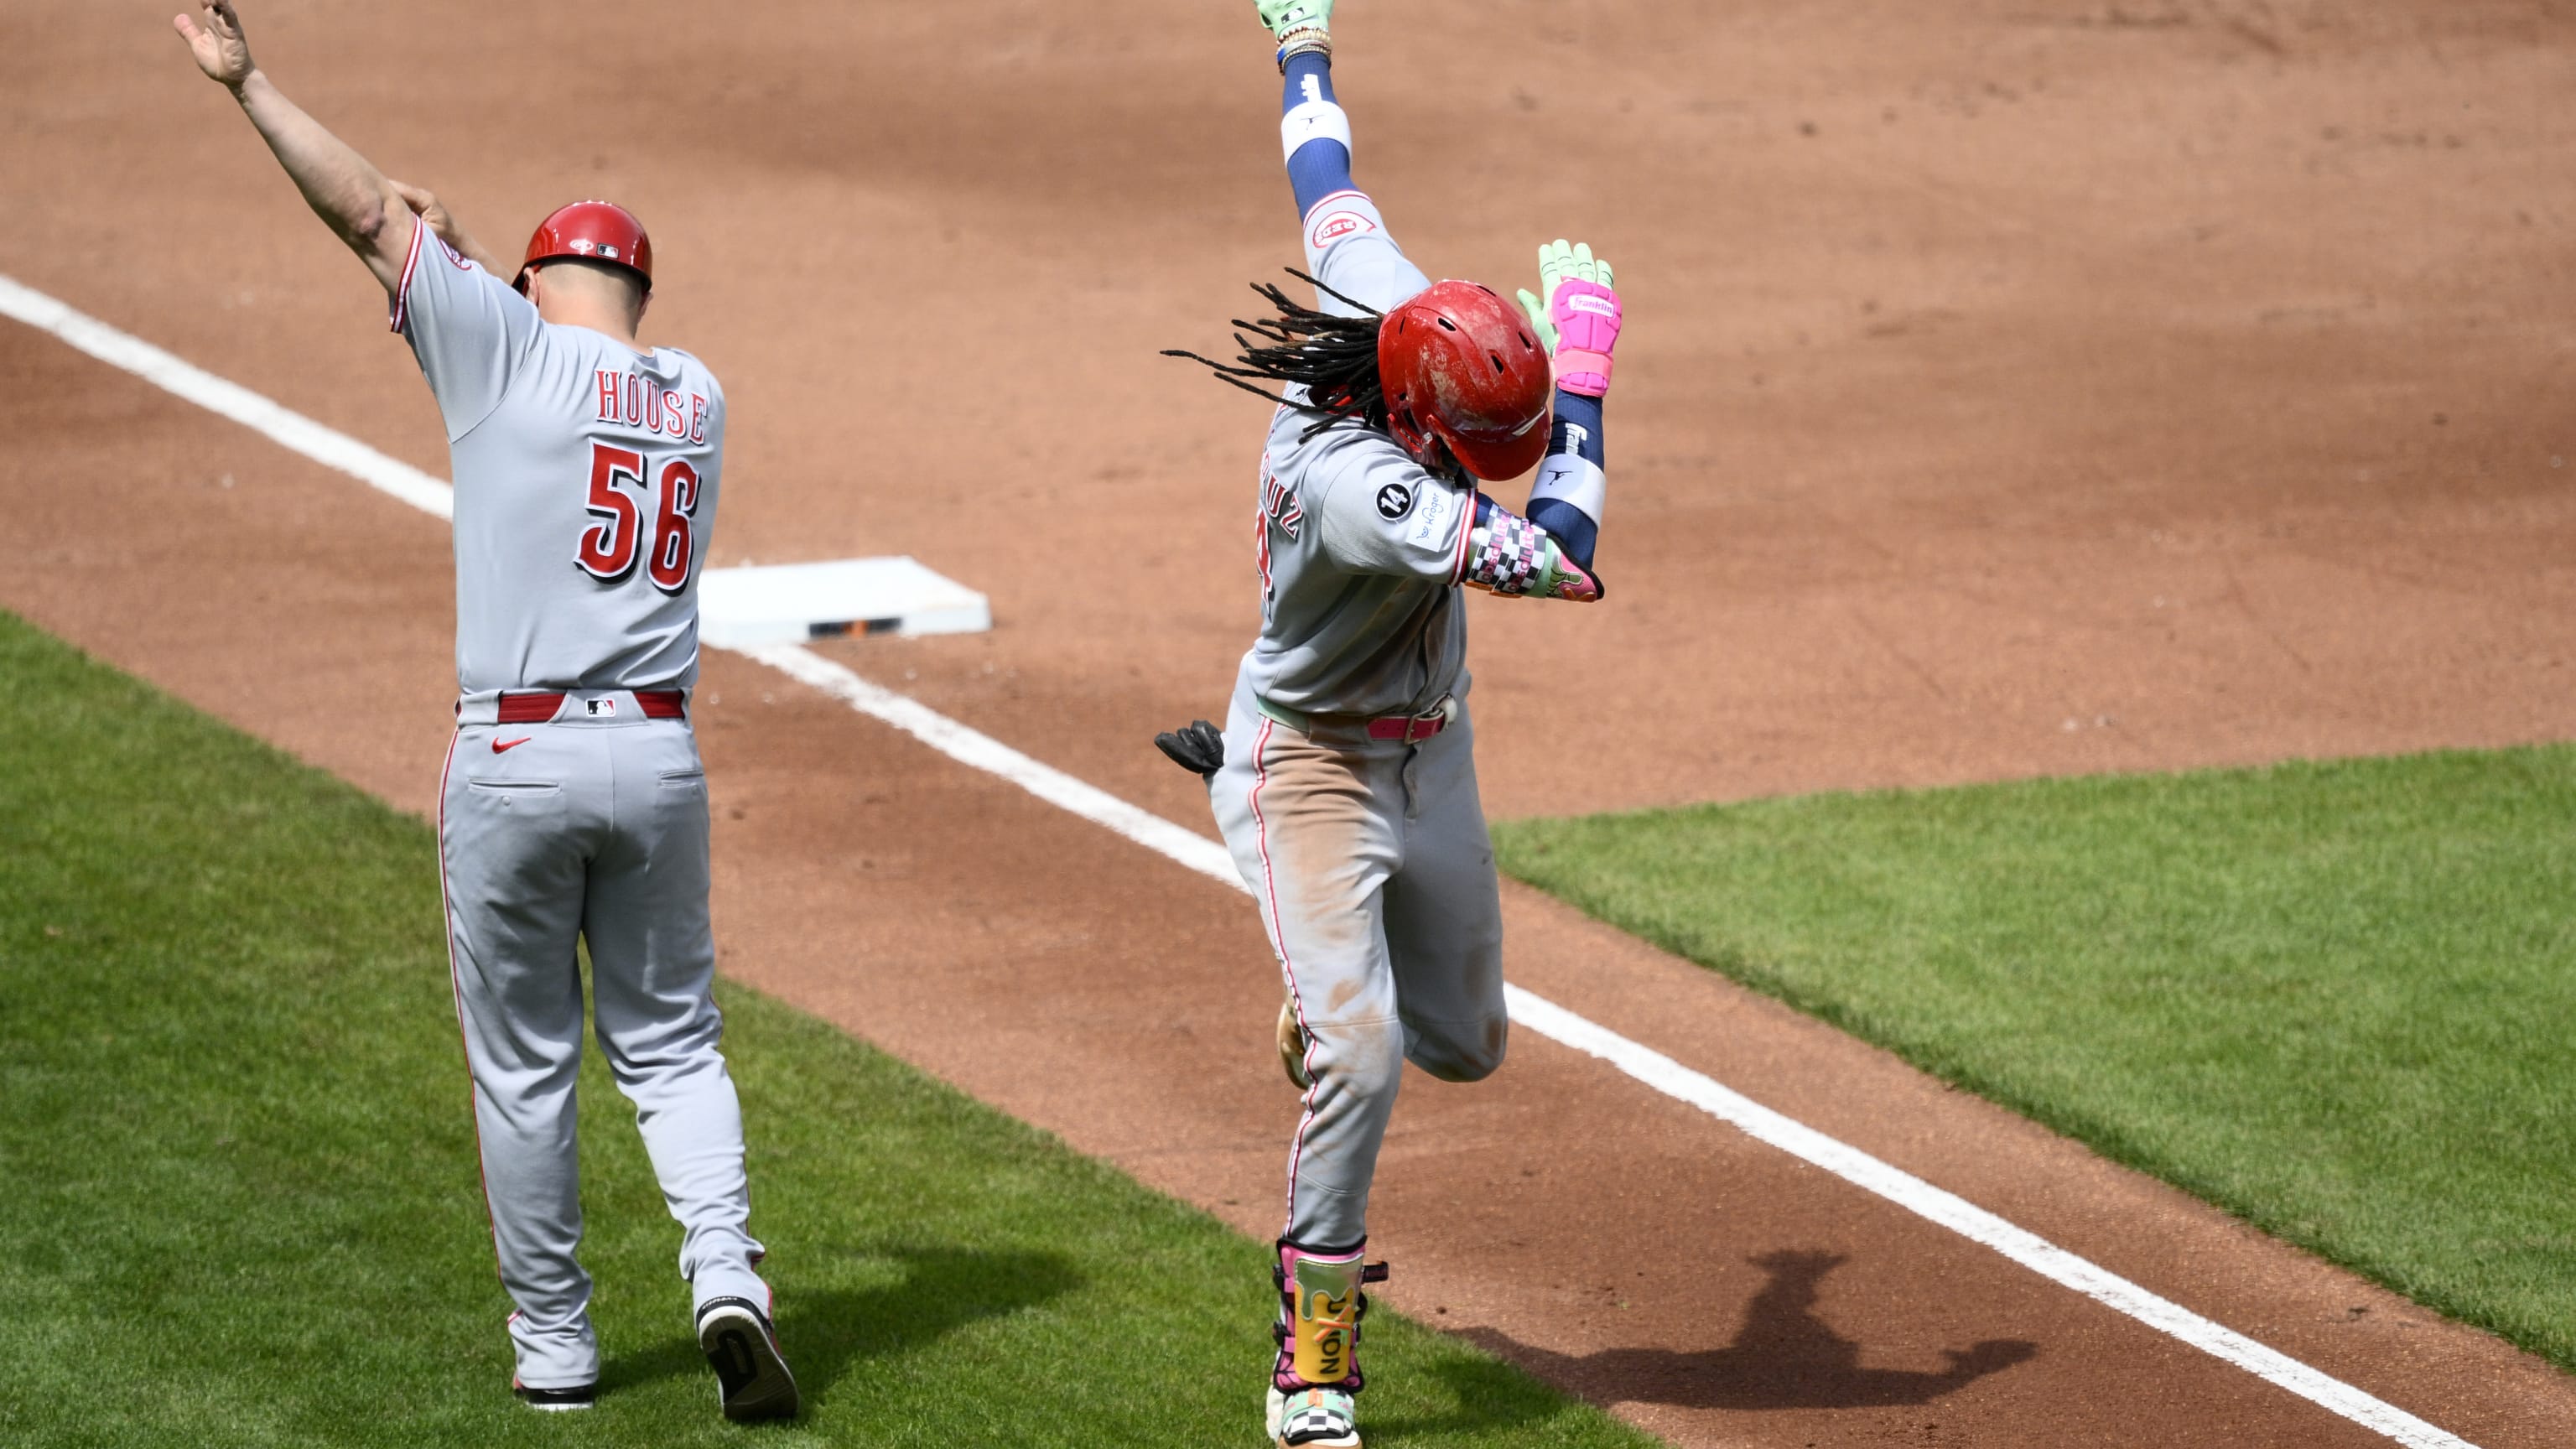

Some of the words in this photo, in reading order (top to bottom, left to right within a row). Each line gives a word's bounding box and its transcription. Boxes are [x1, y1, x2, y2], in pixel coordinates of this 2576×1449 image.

[595, 369, 708, 445] HOUSE
[574, 436, 702, 597] 56
[1380, 486, 1409, 513] 14
[1421, 493, 1444, 525] Kroger
[1319, 1297, 1348, 1374] UION
